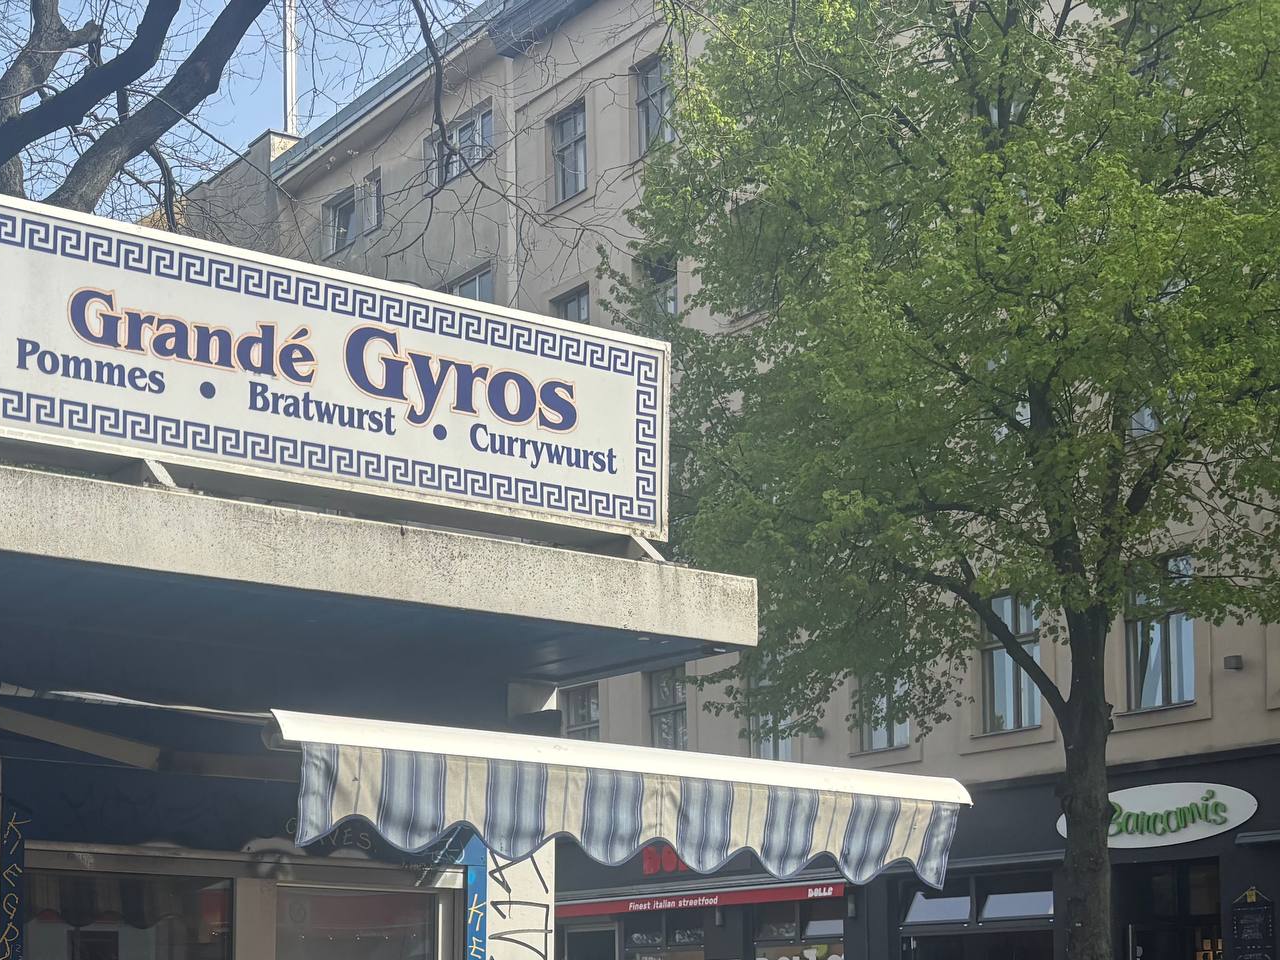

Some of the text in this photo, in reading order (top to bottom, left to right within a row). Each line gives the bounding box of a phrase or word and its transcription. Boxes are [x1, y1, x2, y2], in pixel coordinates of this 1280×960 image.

[17, 338, 618, 476] Pommes Bratwurst Currywurst
[69, 288, 580, 432] Grandé Gyros
[629, 901, 651, 911] Finest
[678, 896, 718, 908] streetfood
